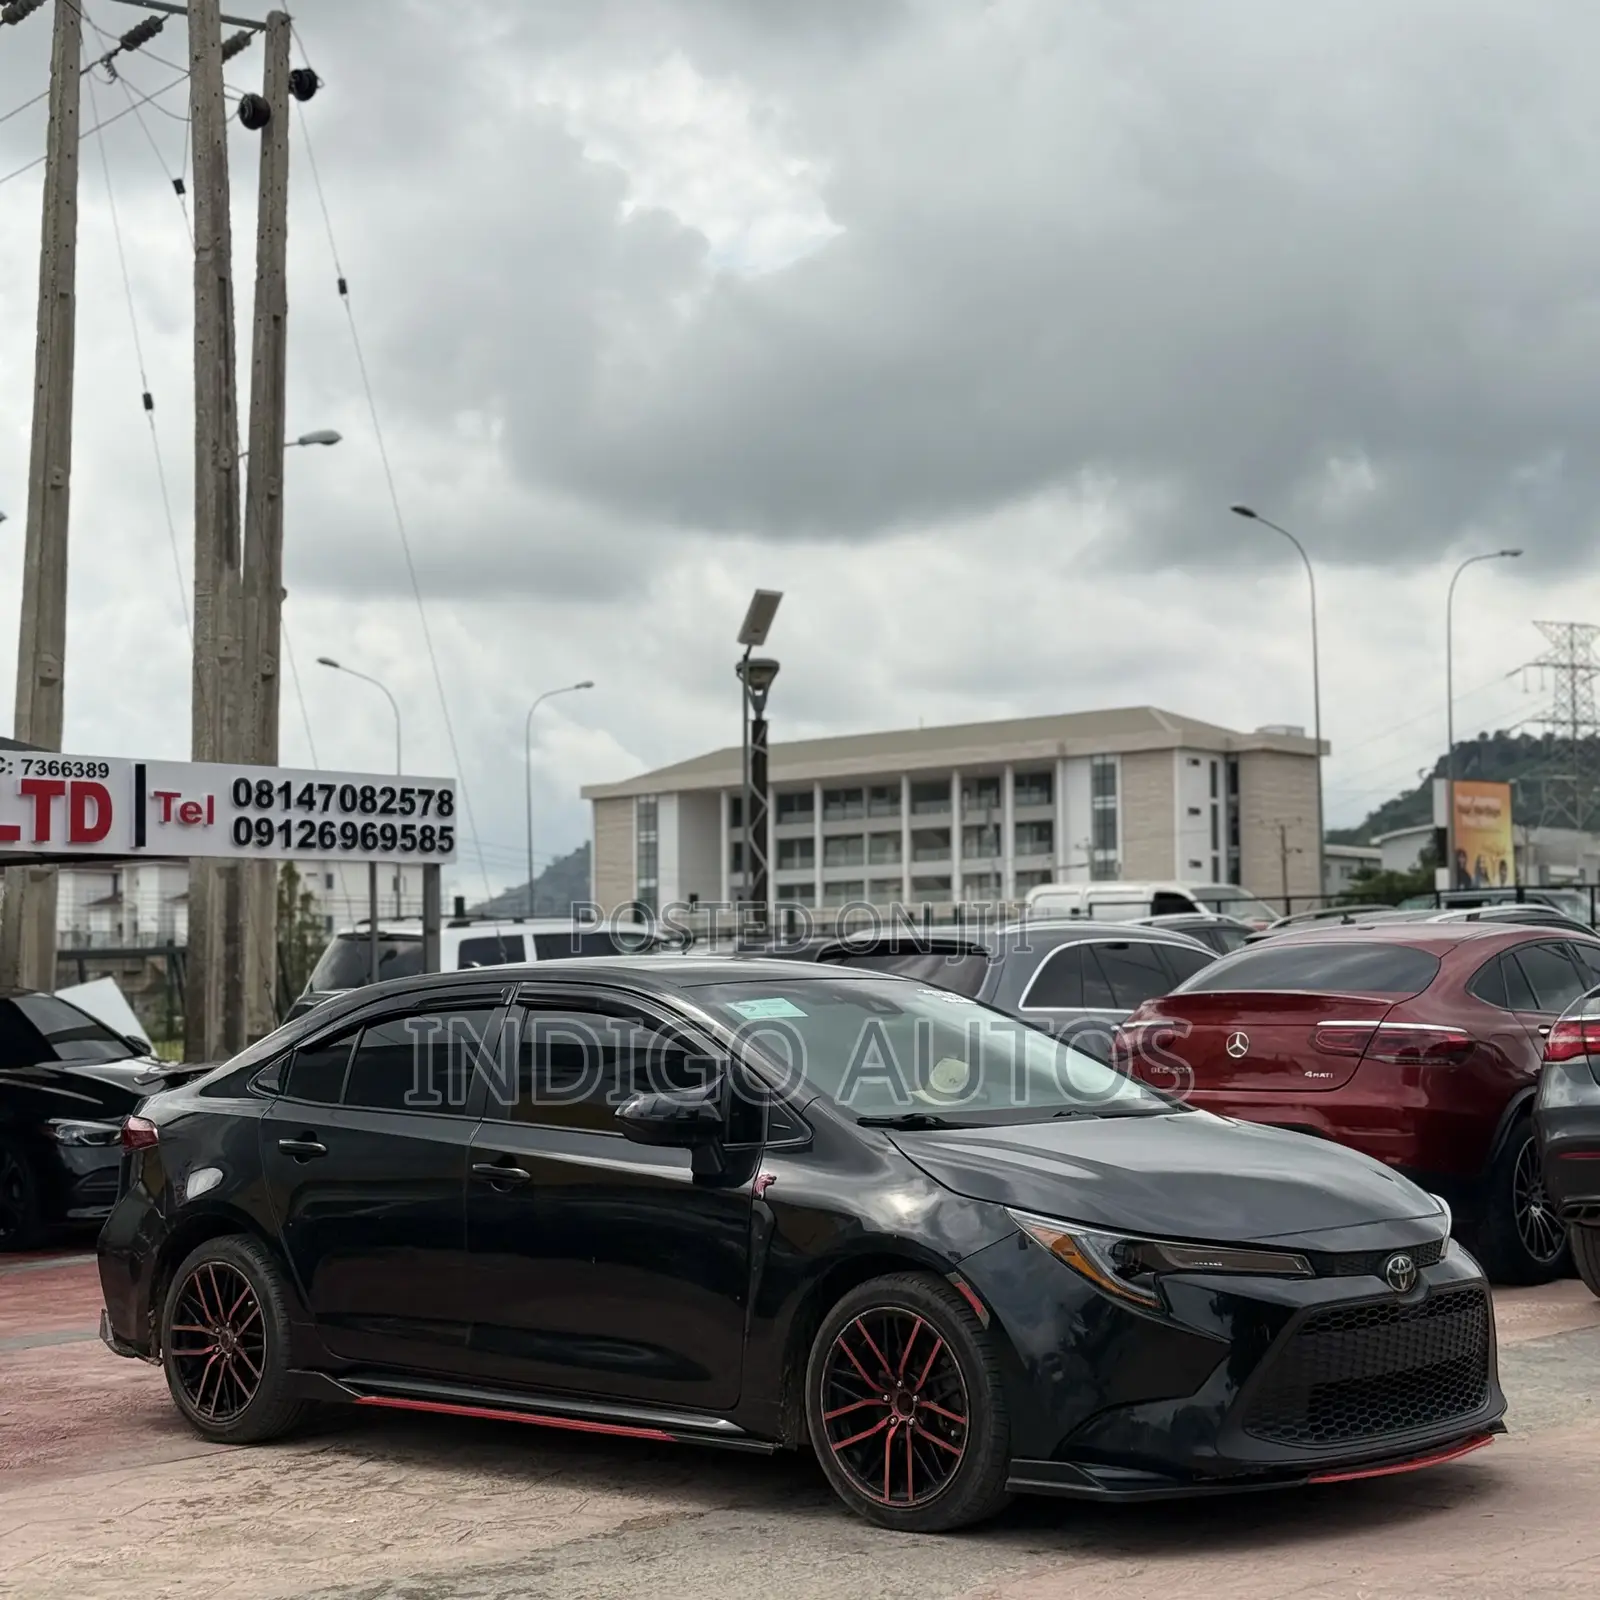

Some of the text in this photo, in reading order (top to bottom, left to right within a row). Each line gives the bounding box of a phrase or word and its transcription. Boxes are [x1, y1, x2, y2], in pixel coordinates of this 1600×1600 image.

[21, 758, 110, 779] 7366389
[0, 778, 113, 844] TD
[152, 790, 215, 826] Tel
[231, 777, 455, 817] 08147082578
[231, 816, 455, 853] 09126969585
